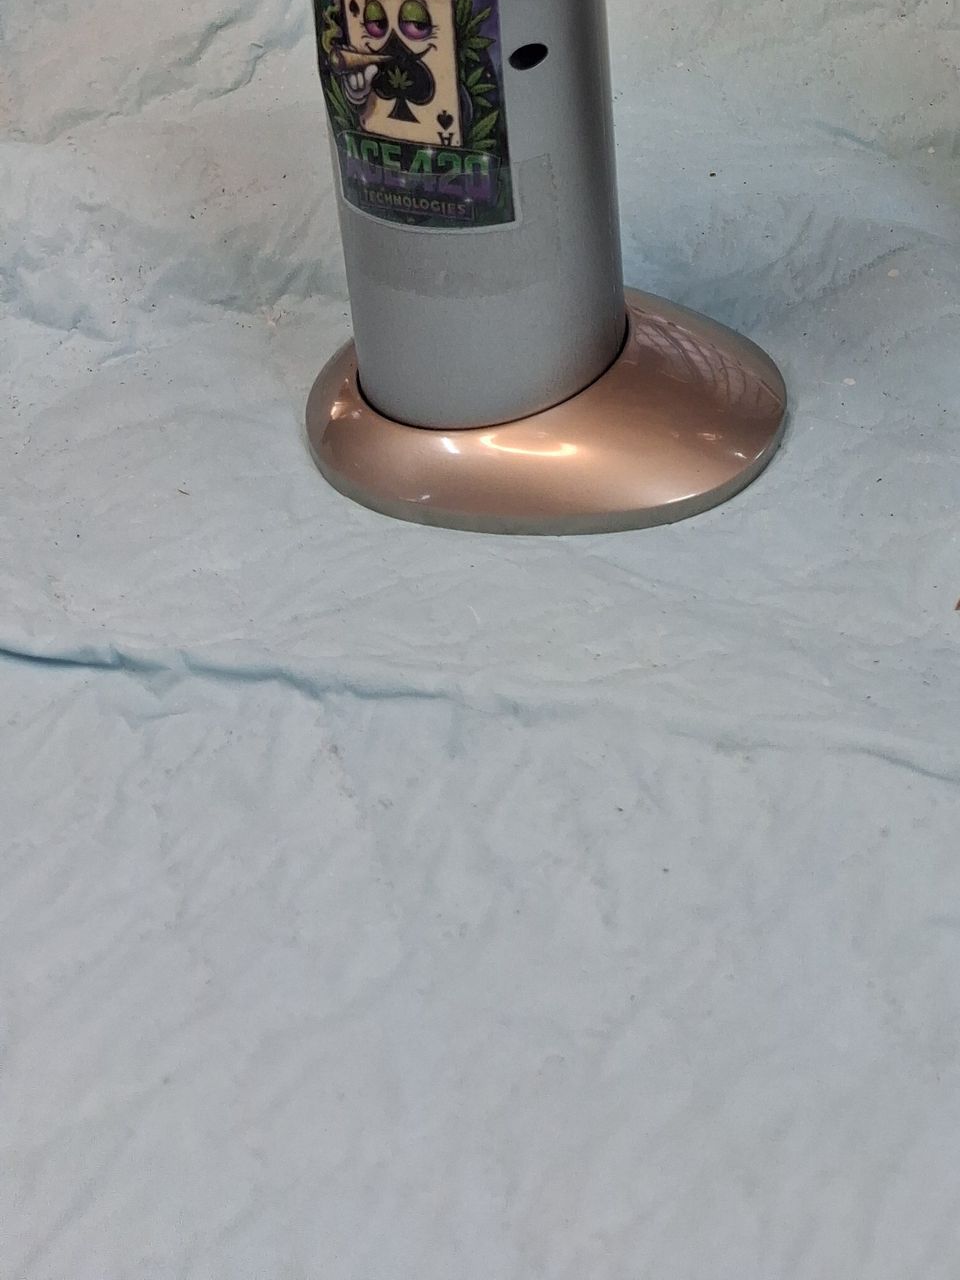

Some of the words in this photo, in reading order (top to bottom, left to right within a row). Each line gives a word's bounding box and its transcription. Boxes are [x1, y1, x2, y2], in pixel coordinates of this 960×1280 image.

[345, 132, 407, 188] ACE
[407, 148, 493, 202] 420
[362, 188, 467, 216] TECHNOLOGIES
